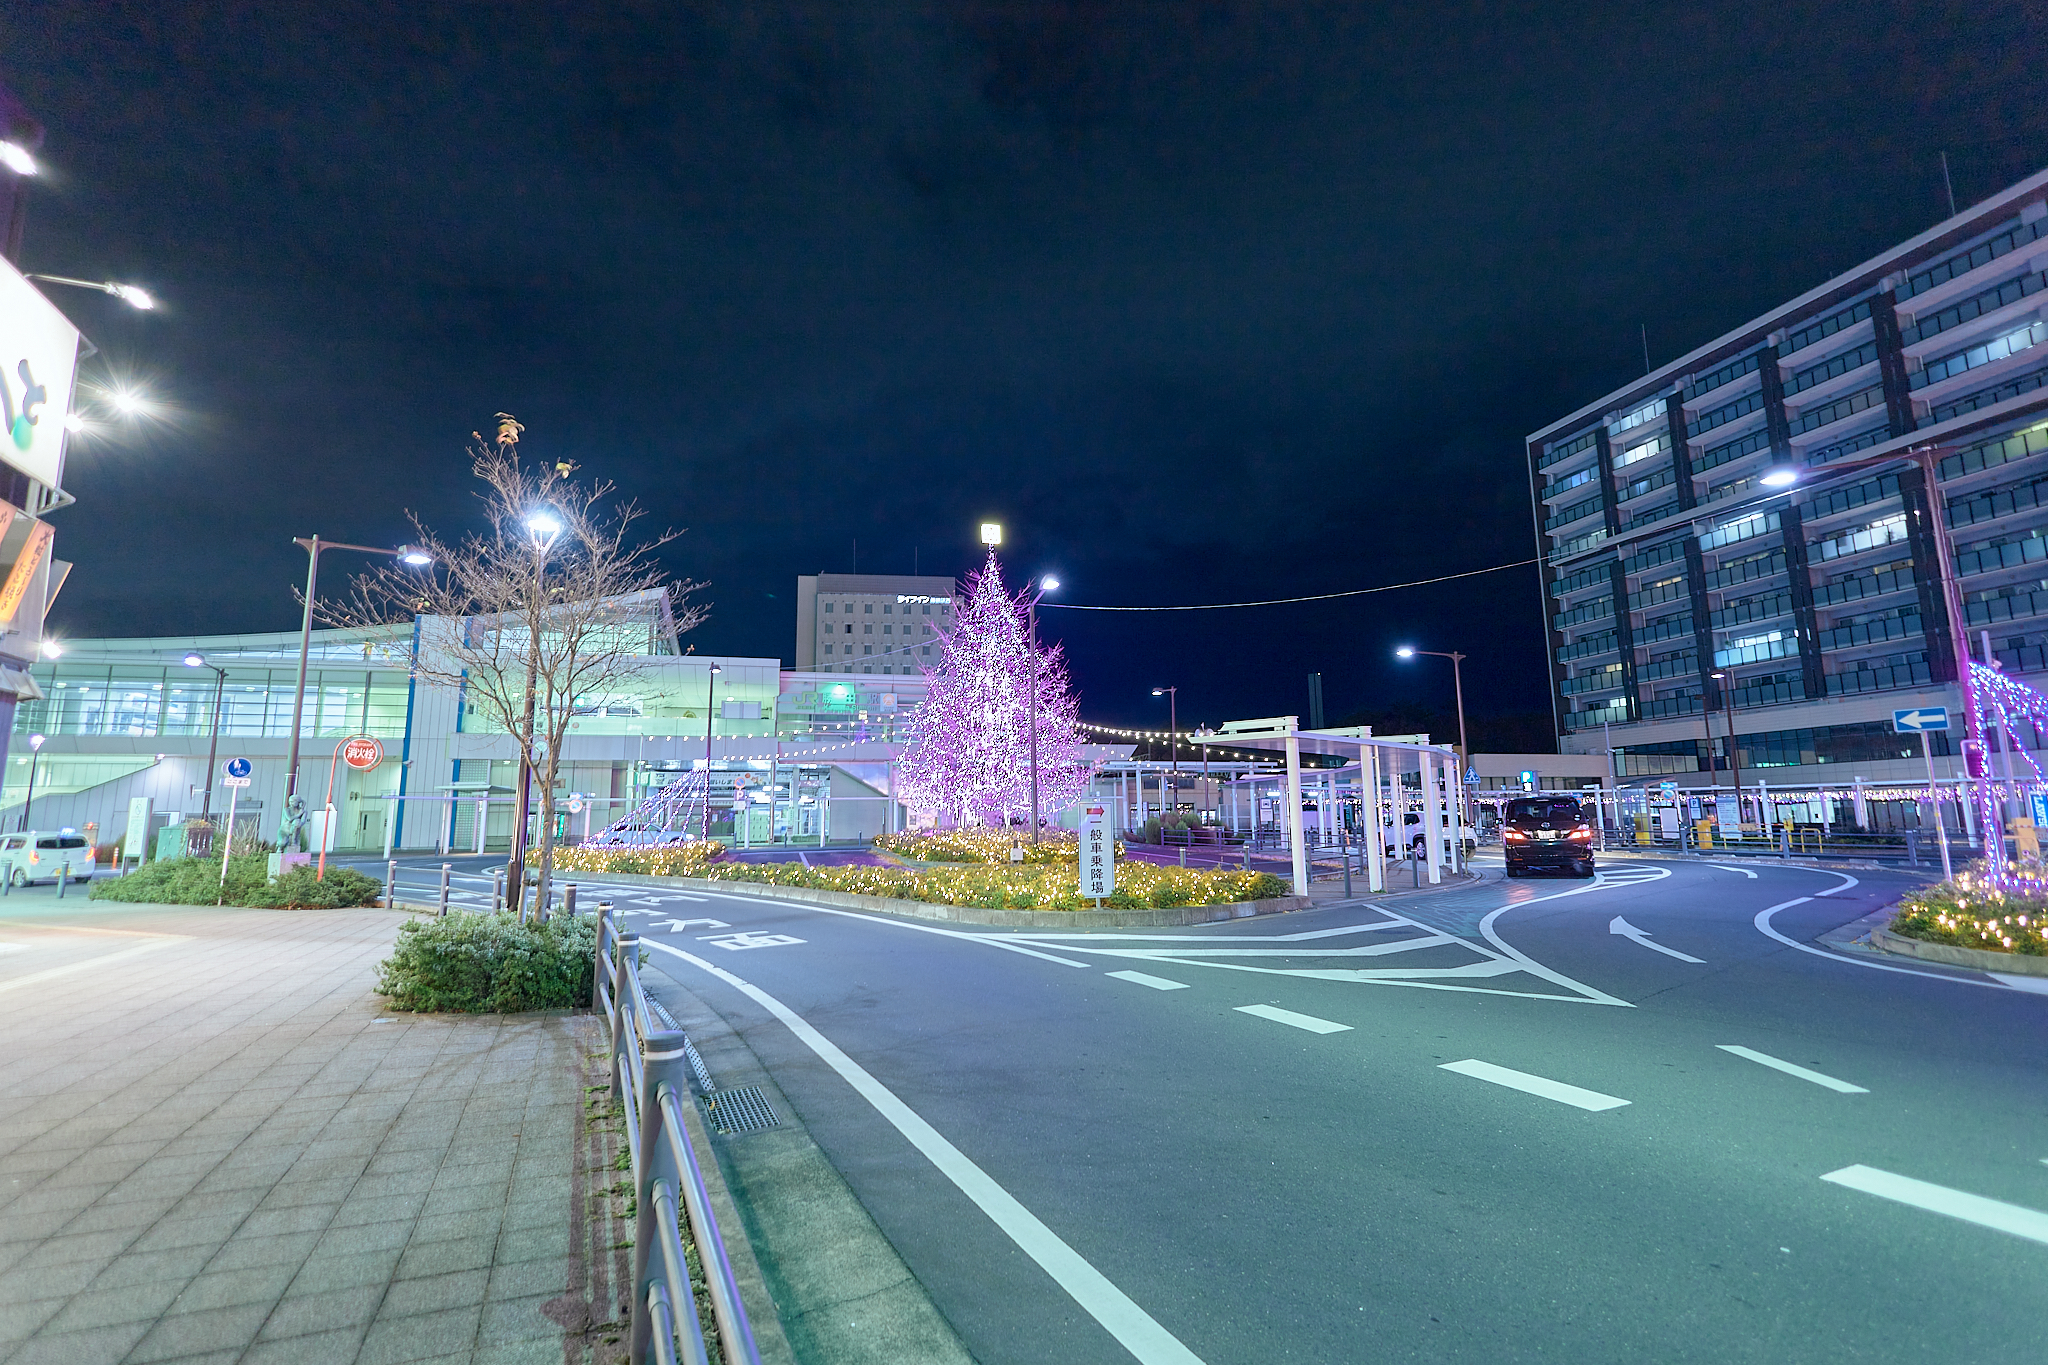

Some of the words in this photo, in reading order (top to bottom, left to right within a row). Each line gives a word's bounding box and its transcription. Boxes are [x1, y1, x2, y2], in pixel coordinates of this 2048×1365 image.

[792, 691, 818, 706] JR
[347, 747, 375, 760] 消火栓
[1523, 772, 1530, 782] P
[736, 791, 745, 800] P
[1090, 820, 1104, 894] 一般車乗降場
